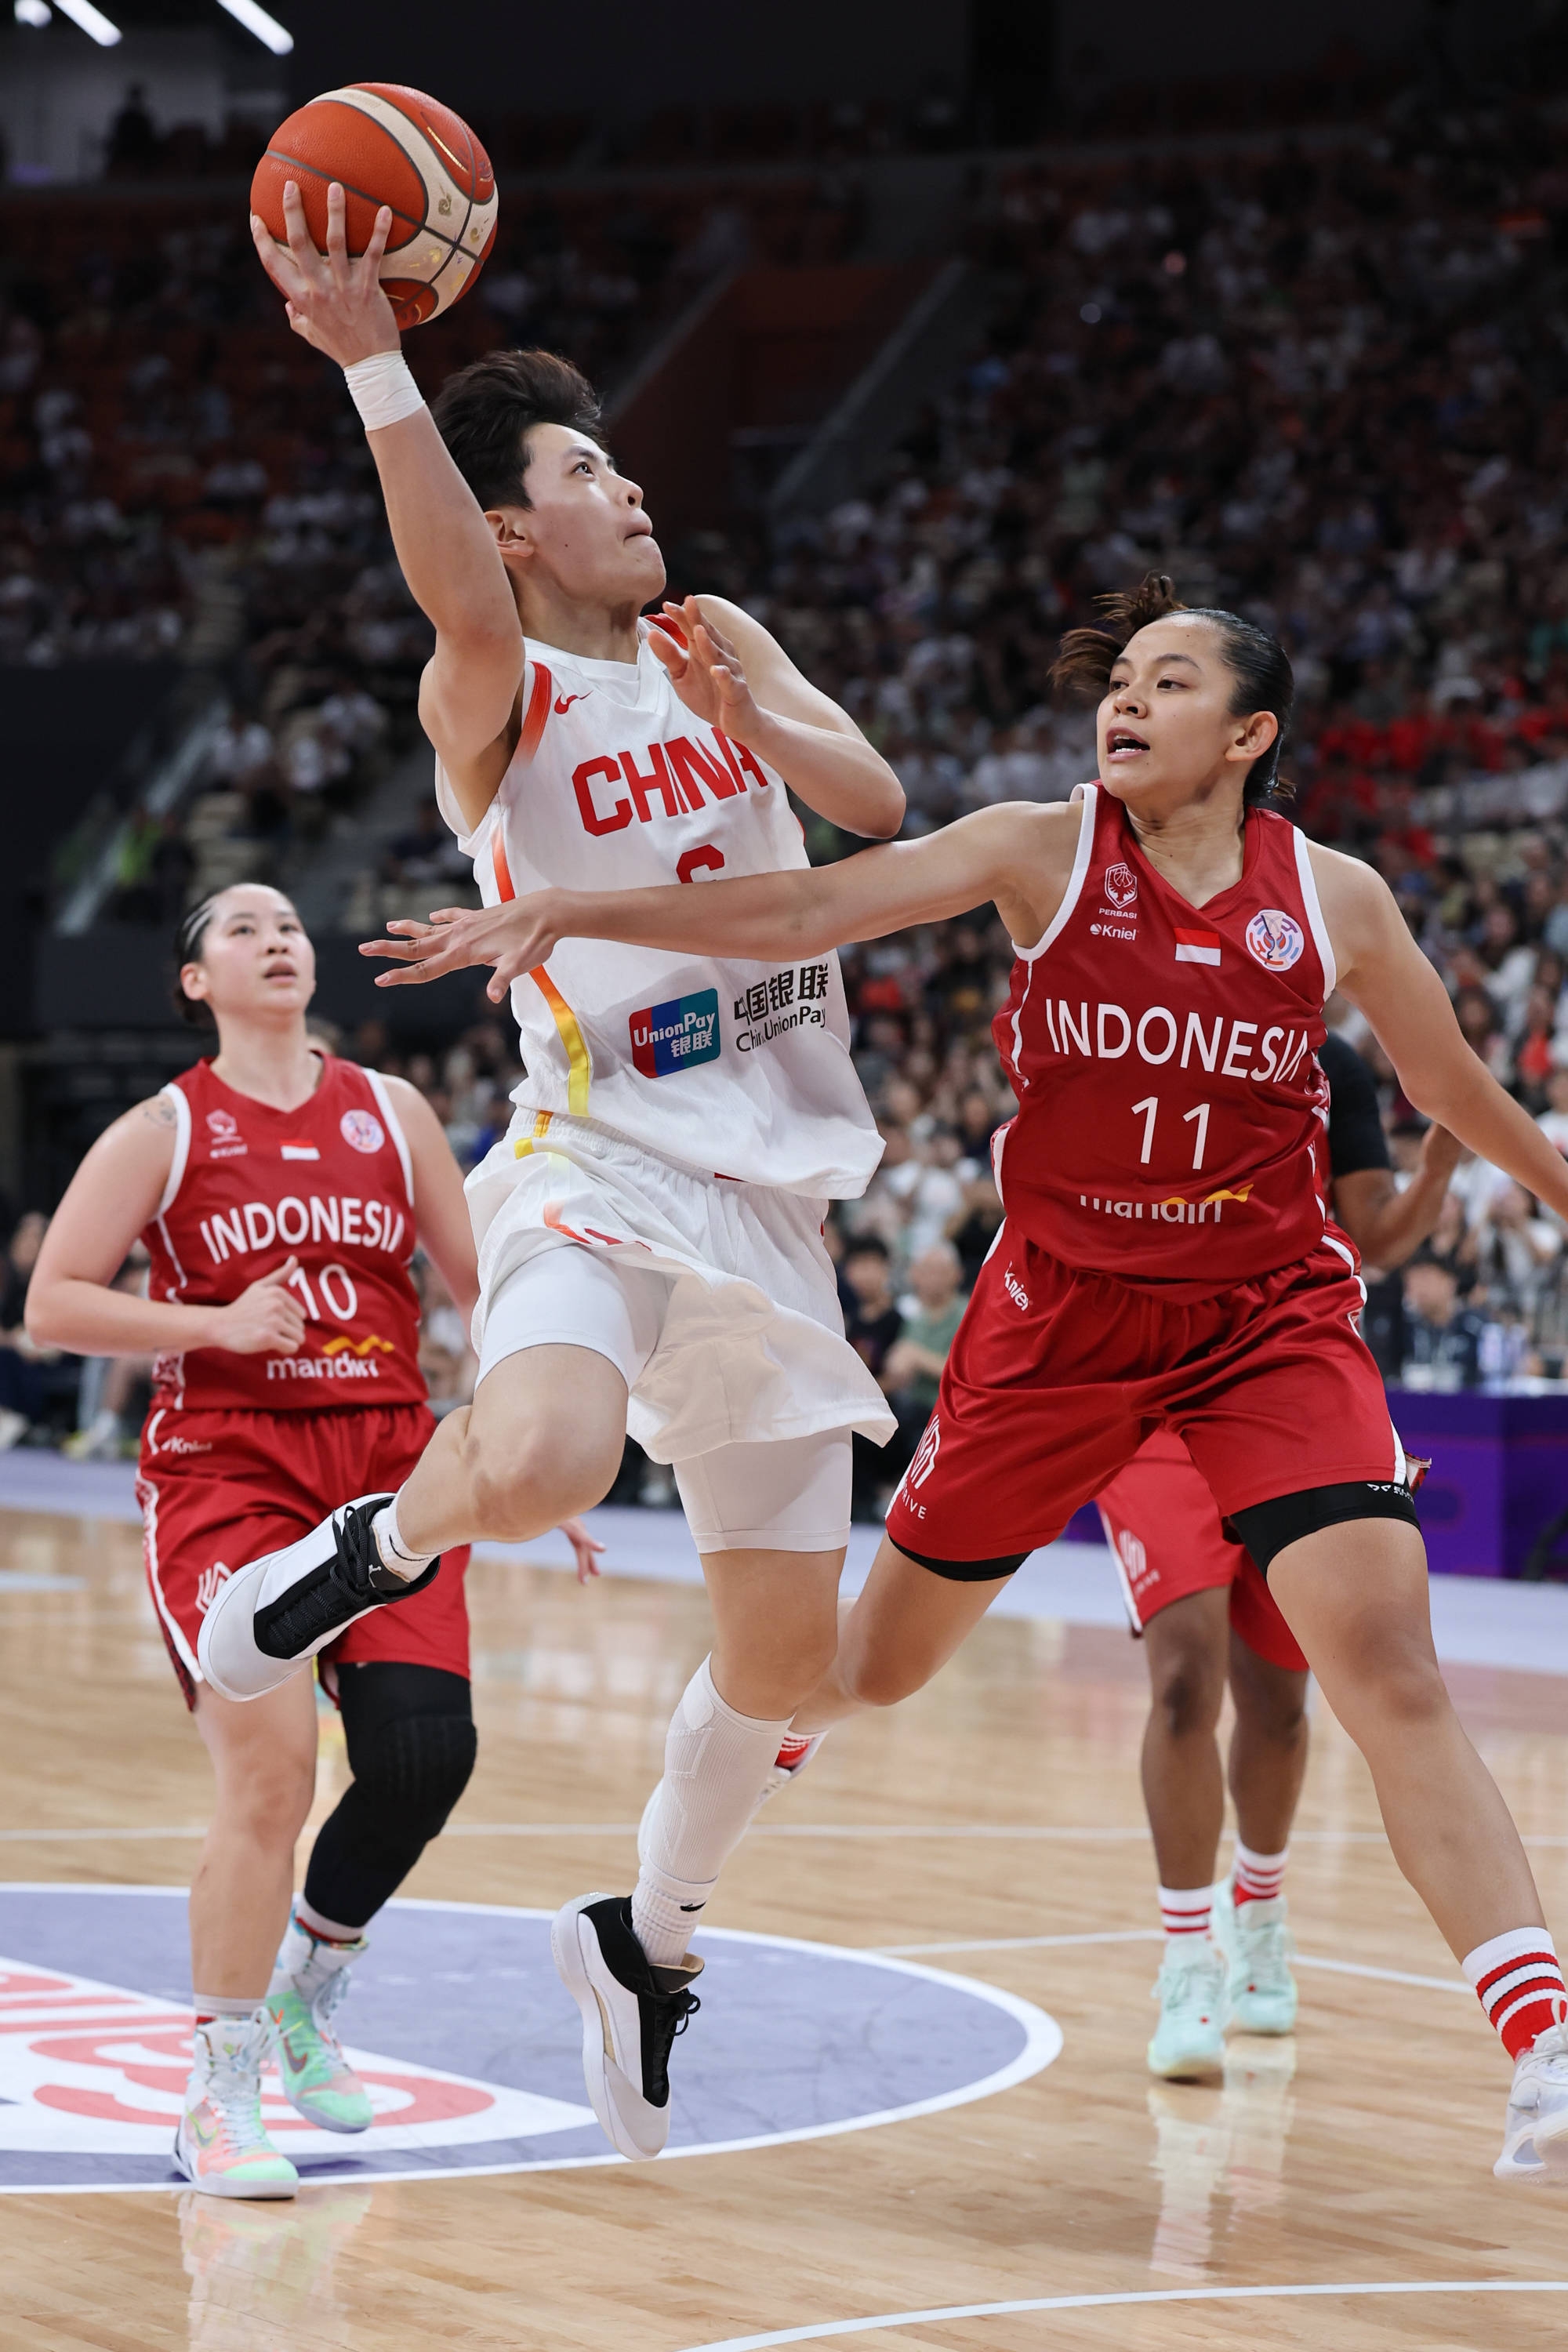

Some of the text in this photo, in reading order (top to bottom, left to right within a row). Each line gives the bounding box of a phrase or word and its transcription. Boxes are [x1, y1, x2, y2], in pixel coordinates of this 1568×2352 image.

[1098, 908, 1138, 920] PERBASI
[1102, 925, 1137, 941] Kniel
[735, 963, 829, 1025] 中国银联
[633, 1012, 716, 1047] UnionPay
[764, 1006, 826, 1041] UnionPay
[671, 1032, 713, 1058] 银联
[1131, 1096, 1210, 1171] 11
[288, 1263, 358, 1321] 10
